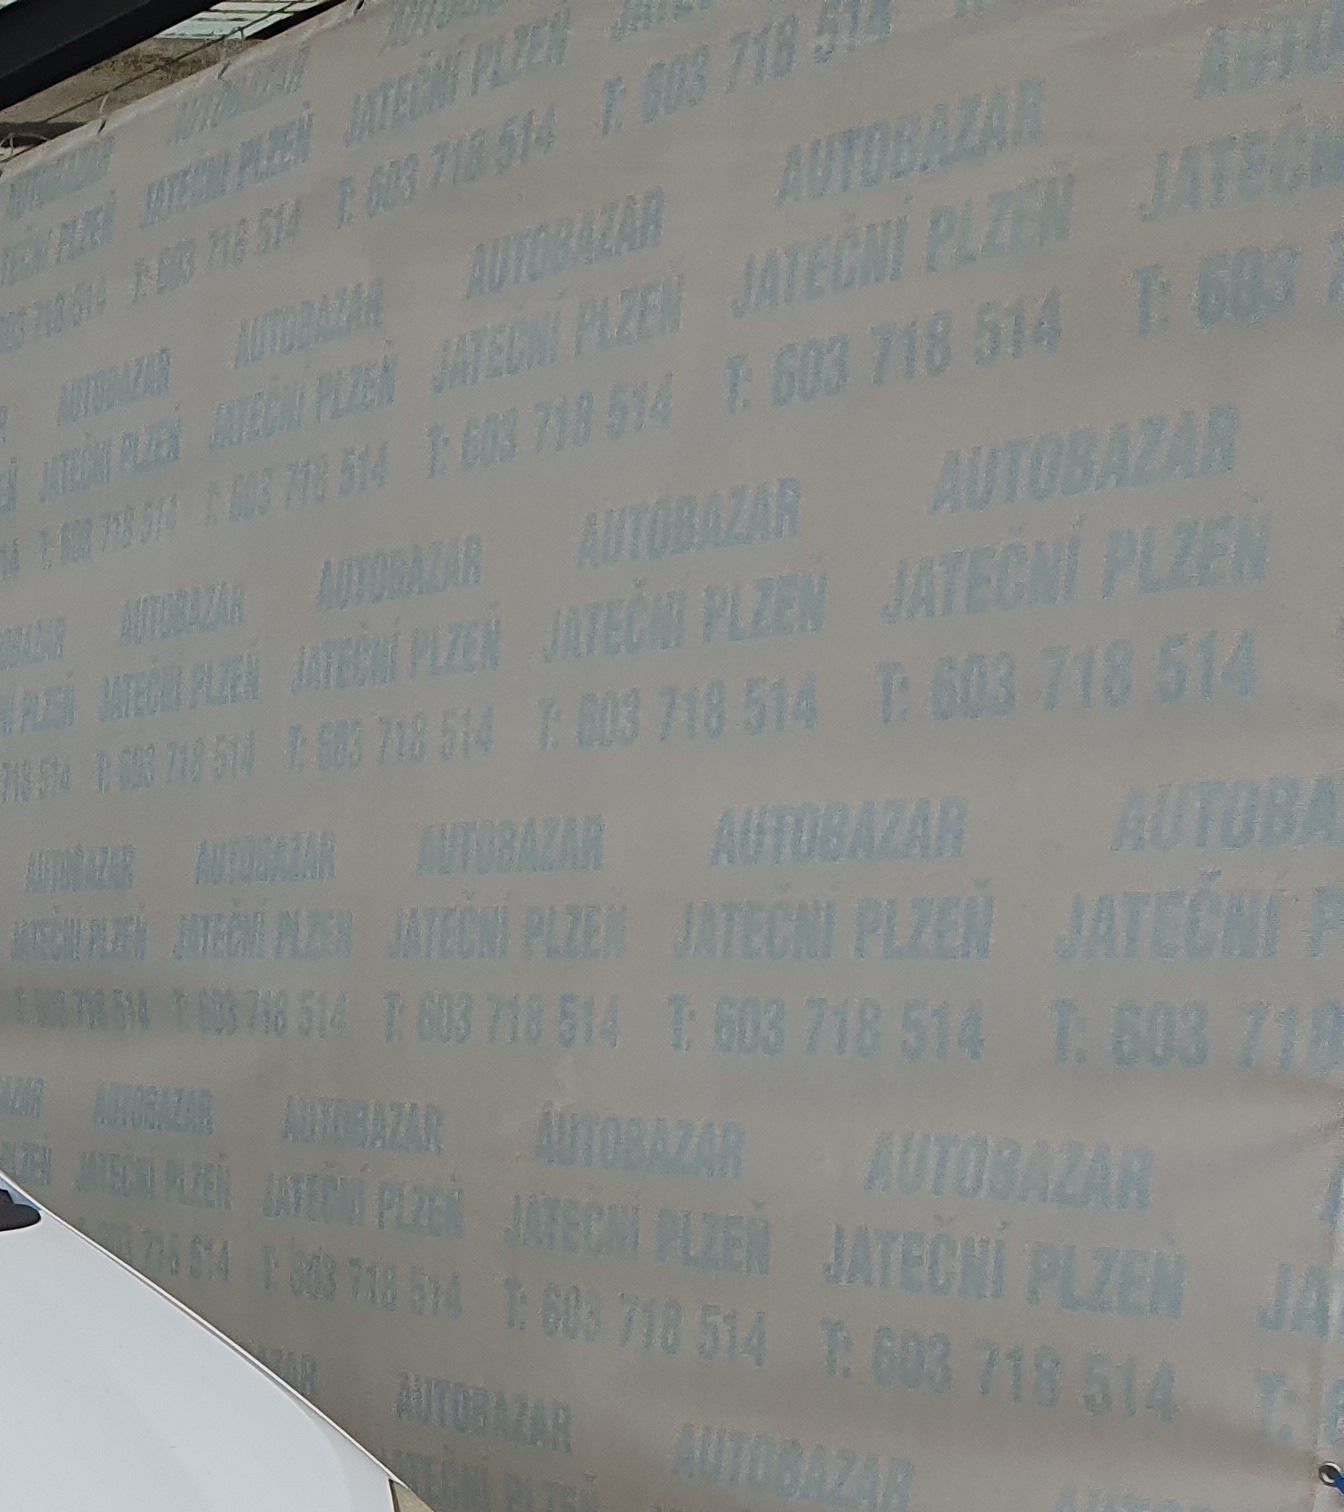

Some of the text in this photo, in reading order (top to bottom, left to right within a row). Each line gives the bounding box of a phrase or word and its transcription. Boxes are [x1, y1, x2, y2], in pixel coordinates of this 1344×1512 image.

[364, 152, 419, 220] 603
[775, 78, 1047, 208] AUTOBAZAR
[464, 187, 666, 302] AUTOBAZAR
[729, 158, 1080, 321] JATEČNÍ PLZEŇ
[573, 258, 686, 361] PLZEŇ
[724, 288, 1064, 417] T: 603 718 514
[57, 345, 172, 426] AUTOBAZAR
[312, 341, 400, 427] PLZEŇ
[426, 423, 451, 479] T:
[460, 408, 518, 473] 603
[605, 371, 674, 441] 514
[929, 402, 1242, 516] AUTOBAZAR
[576, 477, 802, 569] AUTOBAZAR
[880, 493, 1275, 627] JATEČNÍ PLZEŇ
[291, 602, 503, 697] JATEČNÍ PLZEŇ
[541, 555, 831, 665] JATEČNÍ PLZEŇ
[188, 640, 262, 711] PLZEŇ
[575, 687, 642, 752] 603
[658, 679, 725, 745] 718
[741, 674, 820, 738] 514
[876, 629, 1261, 729] T: 603 718 514
[95, 748, 112, 796] T:
[118, 743, 157, 793] 603
[287, 704, 495, 776] T: 603 718 514
[416, 815, 605, 877] AUTOBAZAR
[709, 796, 969, 870] AUTOBAZAR
[382, 889, 627, 962] JATEČNÍ PLZEŇ
[672, 877, 996, 963] JATEČNÍ PLZEŇ
[1056, 868, 1289, 960] JATEČNÍ
[296, 989, 350, 1039] 514
[383, 990, 407, 1044] T:
[415, 991, 474, 1046] 603
[486, 993, 544, 1048] 718
[667, 993, 986, 1064] T: 603 718 514
[1050, 999, 1088, 1064] T:
[1113, 1001, 1209, 1069] 603
[531, 1109, 747, 1184] AUTOBAZAR
[862, 1131, 1155, 1219] AUTOBAZAR
[376, 1174, 466, 1243] PLZEŇ
[654, 1203, 773, 1280] PLZEŇ
[821, 1219, 1189, 1323] JATEČNÍ PLZEŇ
[695, 1302, 769, 1371] 514
[820, 1318, 1184, 1431] T: 603 718 514
